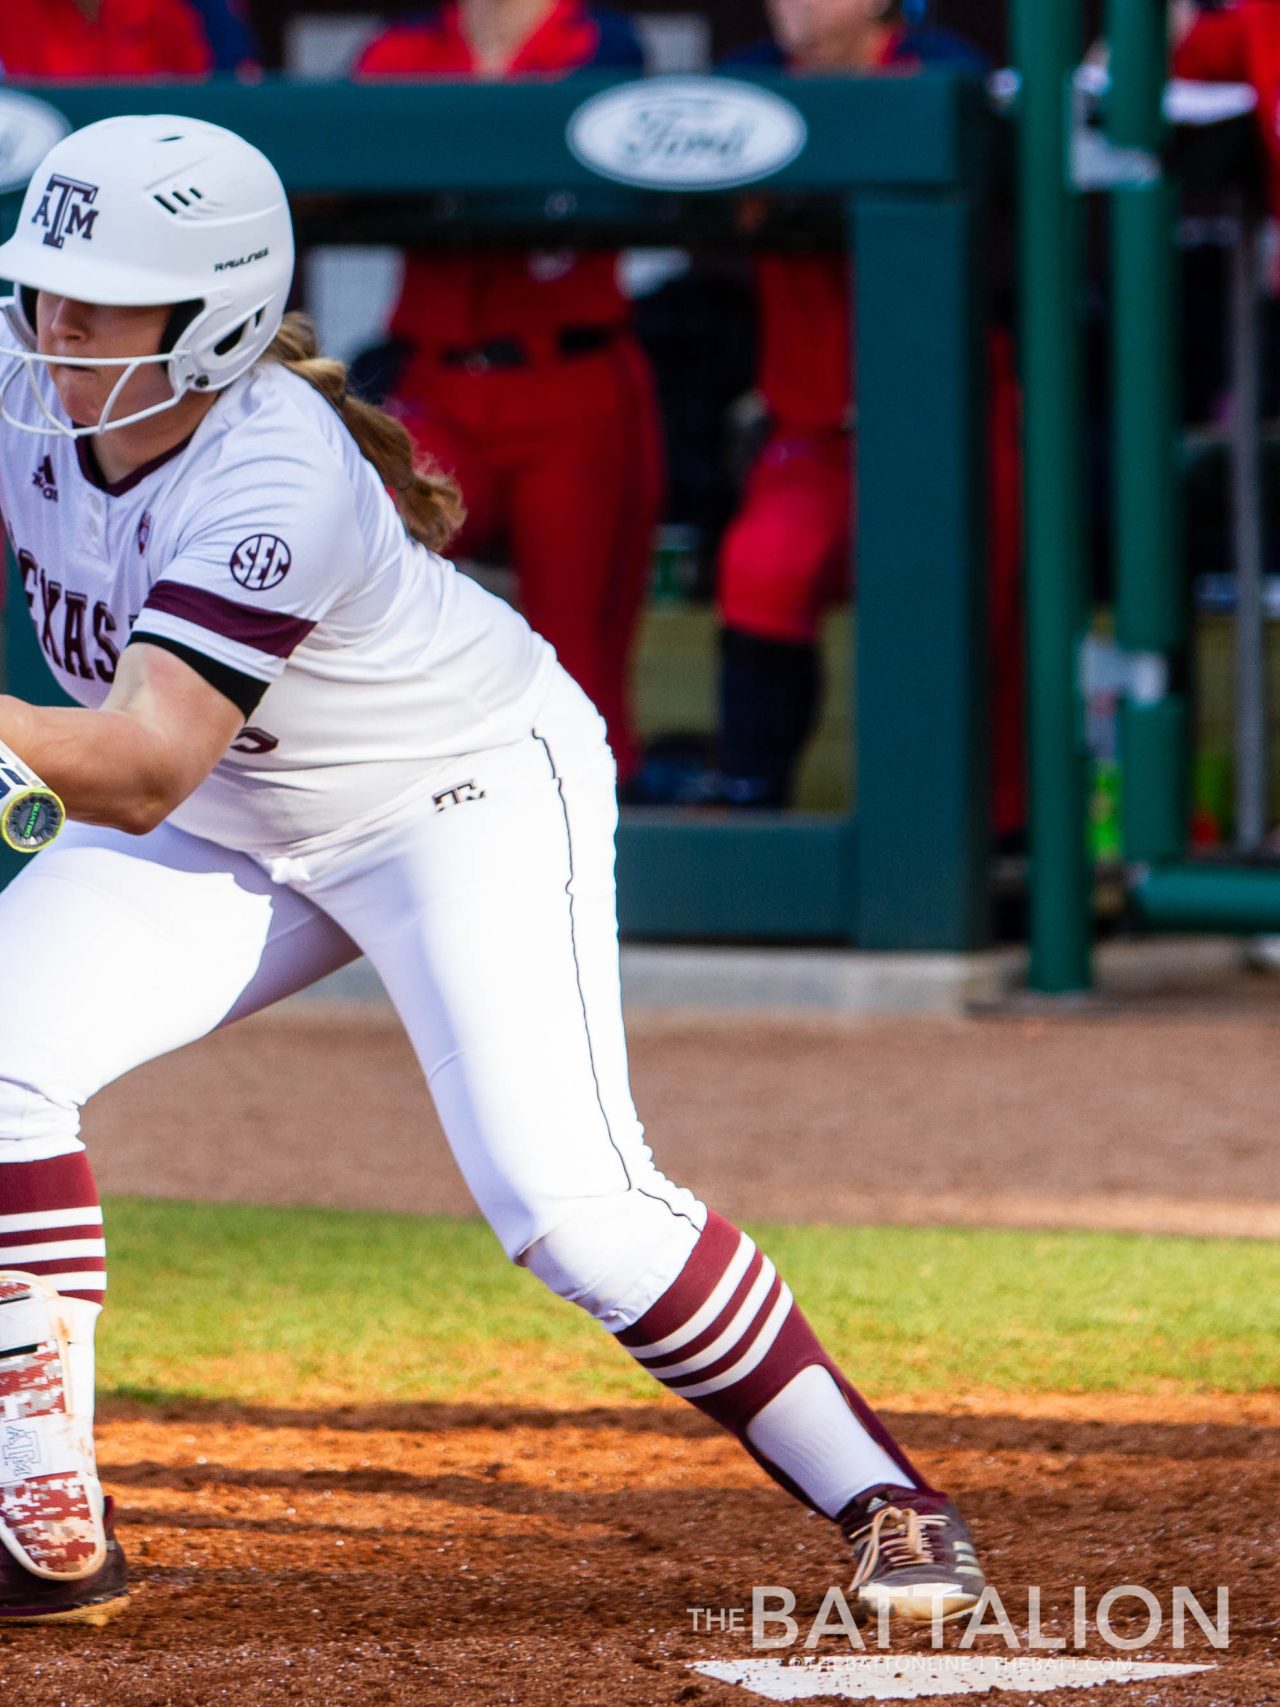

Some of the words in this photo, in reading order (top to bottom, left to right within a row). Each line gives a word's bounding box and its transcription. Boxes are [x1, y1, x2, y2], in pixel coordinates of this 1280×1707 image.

[621, 101, 754, 163] Ford
[213, 247, 269, 272] RAWLINGS
[230, 534, 291, 590] SEC
[10, 530, 121, 684] EXAS
